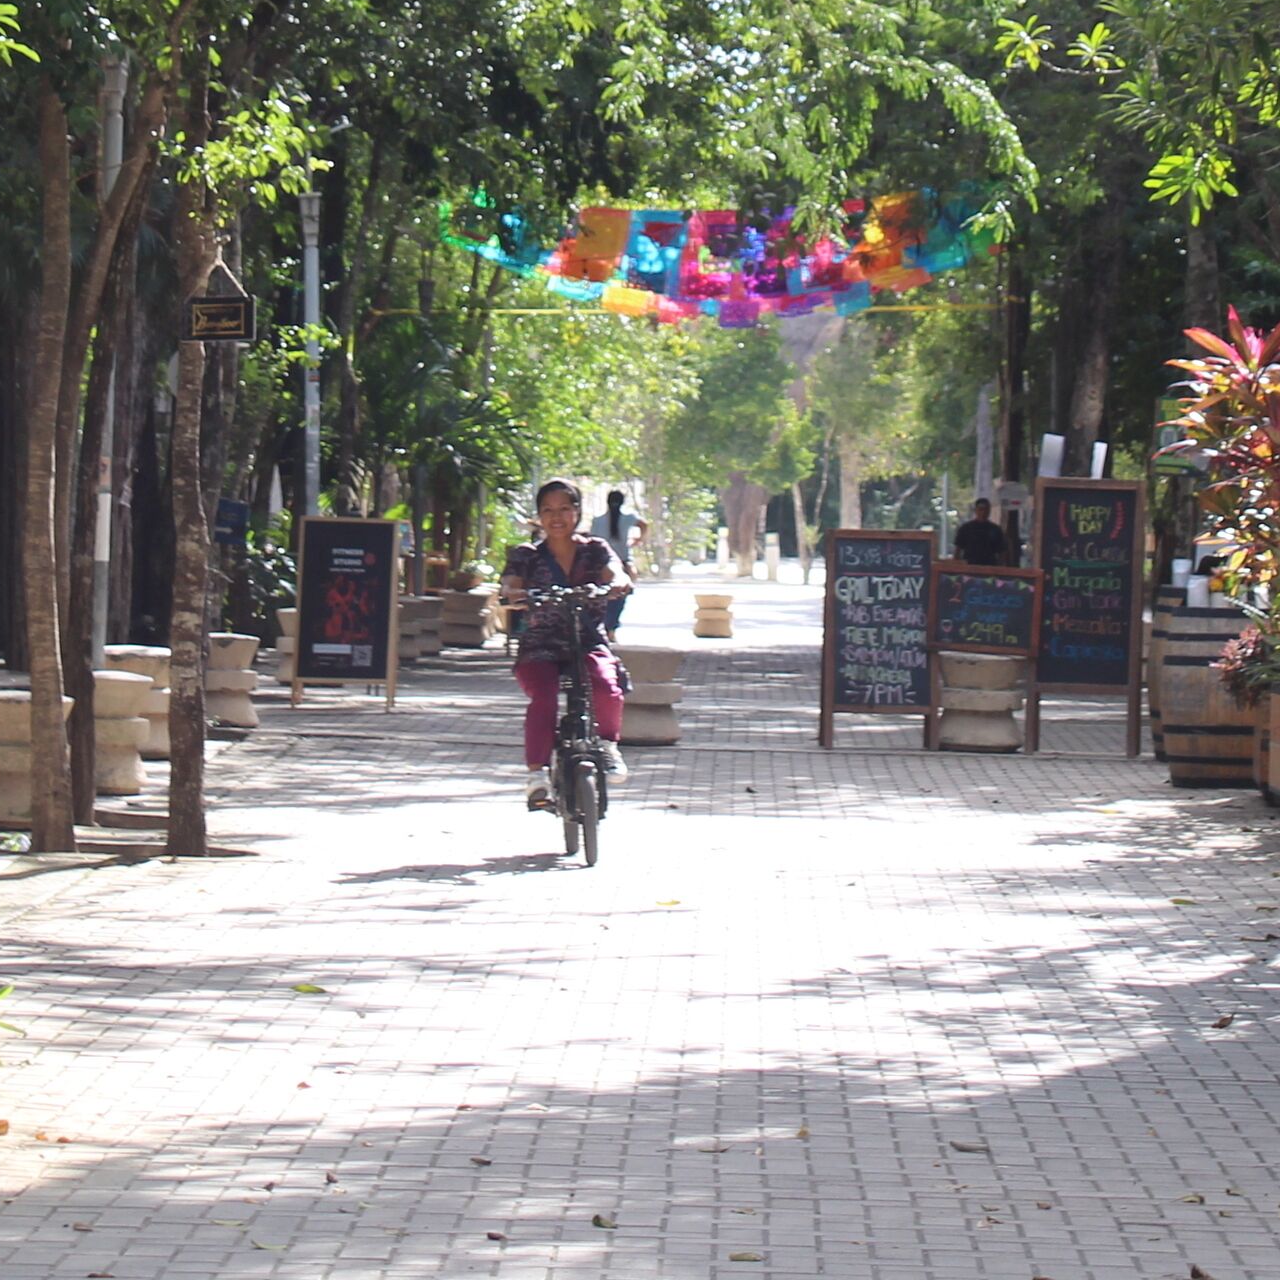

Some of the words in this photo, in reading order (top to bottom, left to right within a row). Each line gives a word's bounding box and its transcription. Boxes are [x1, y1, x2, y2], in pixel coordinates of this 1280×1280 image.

[1069, 503, 1112, 523] HAPPY
[1077, 520, 1103, 535] DAY
[947, 581, 962, 604] 2
